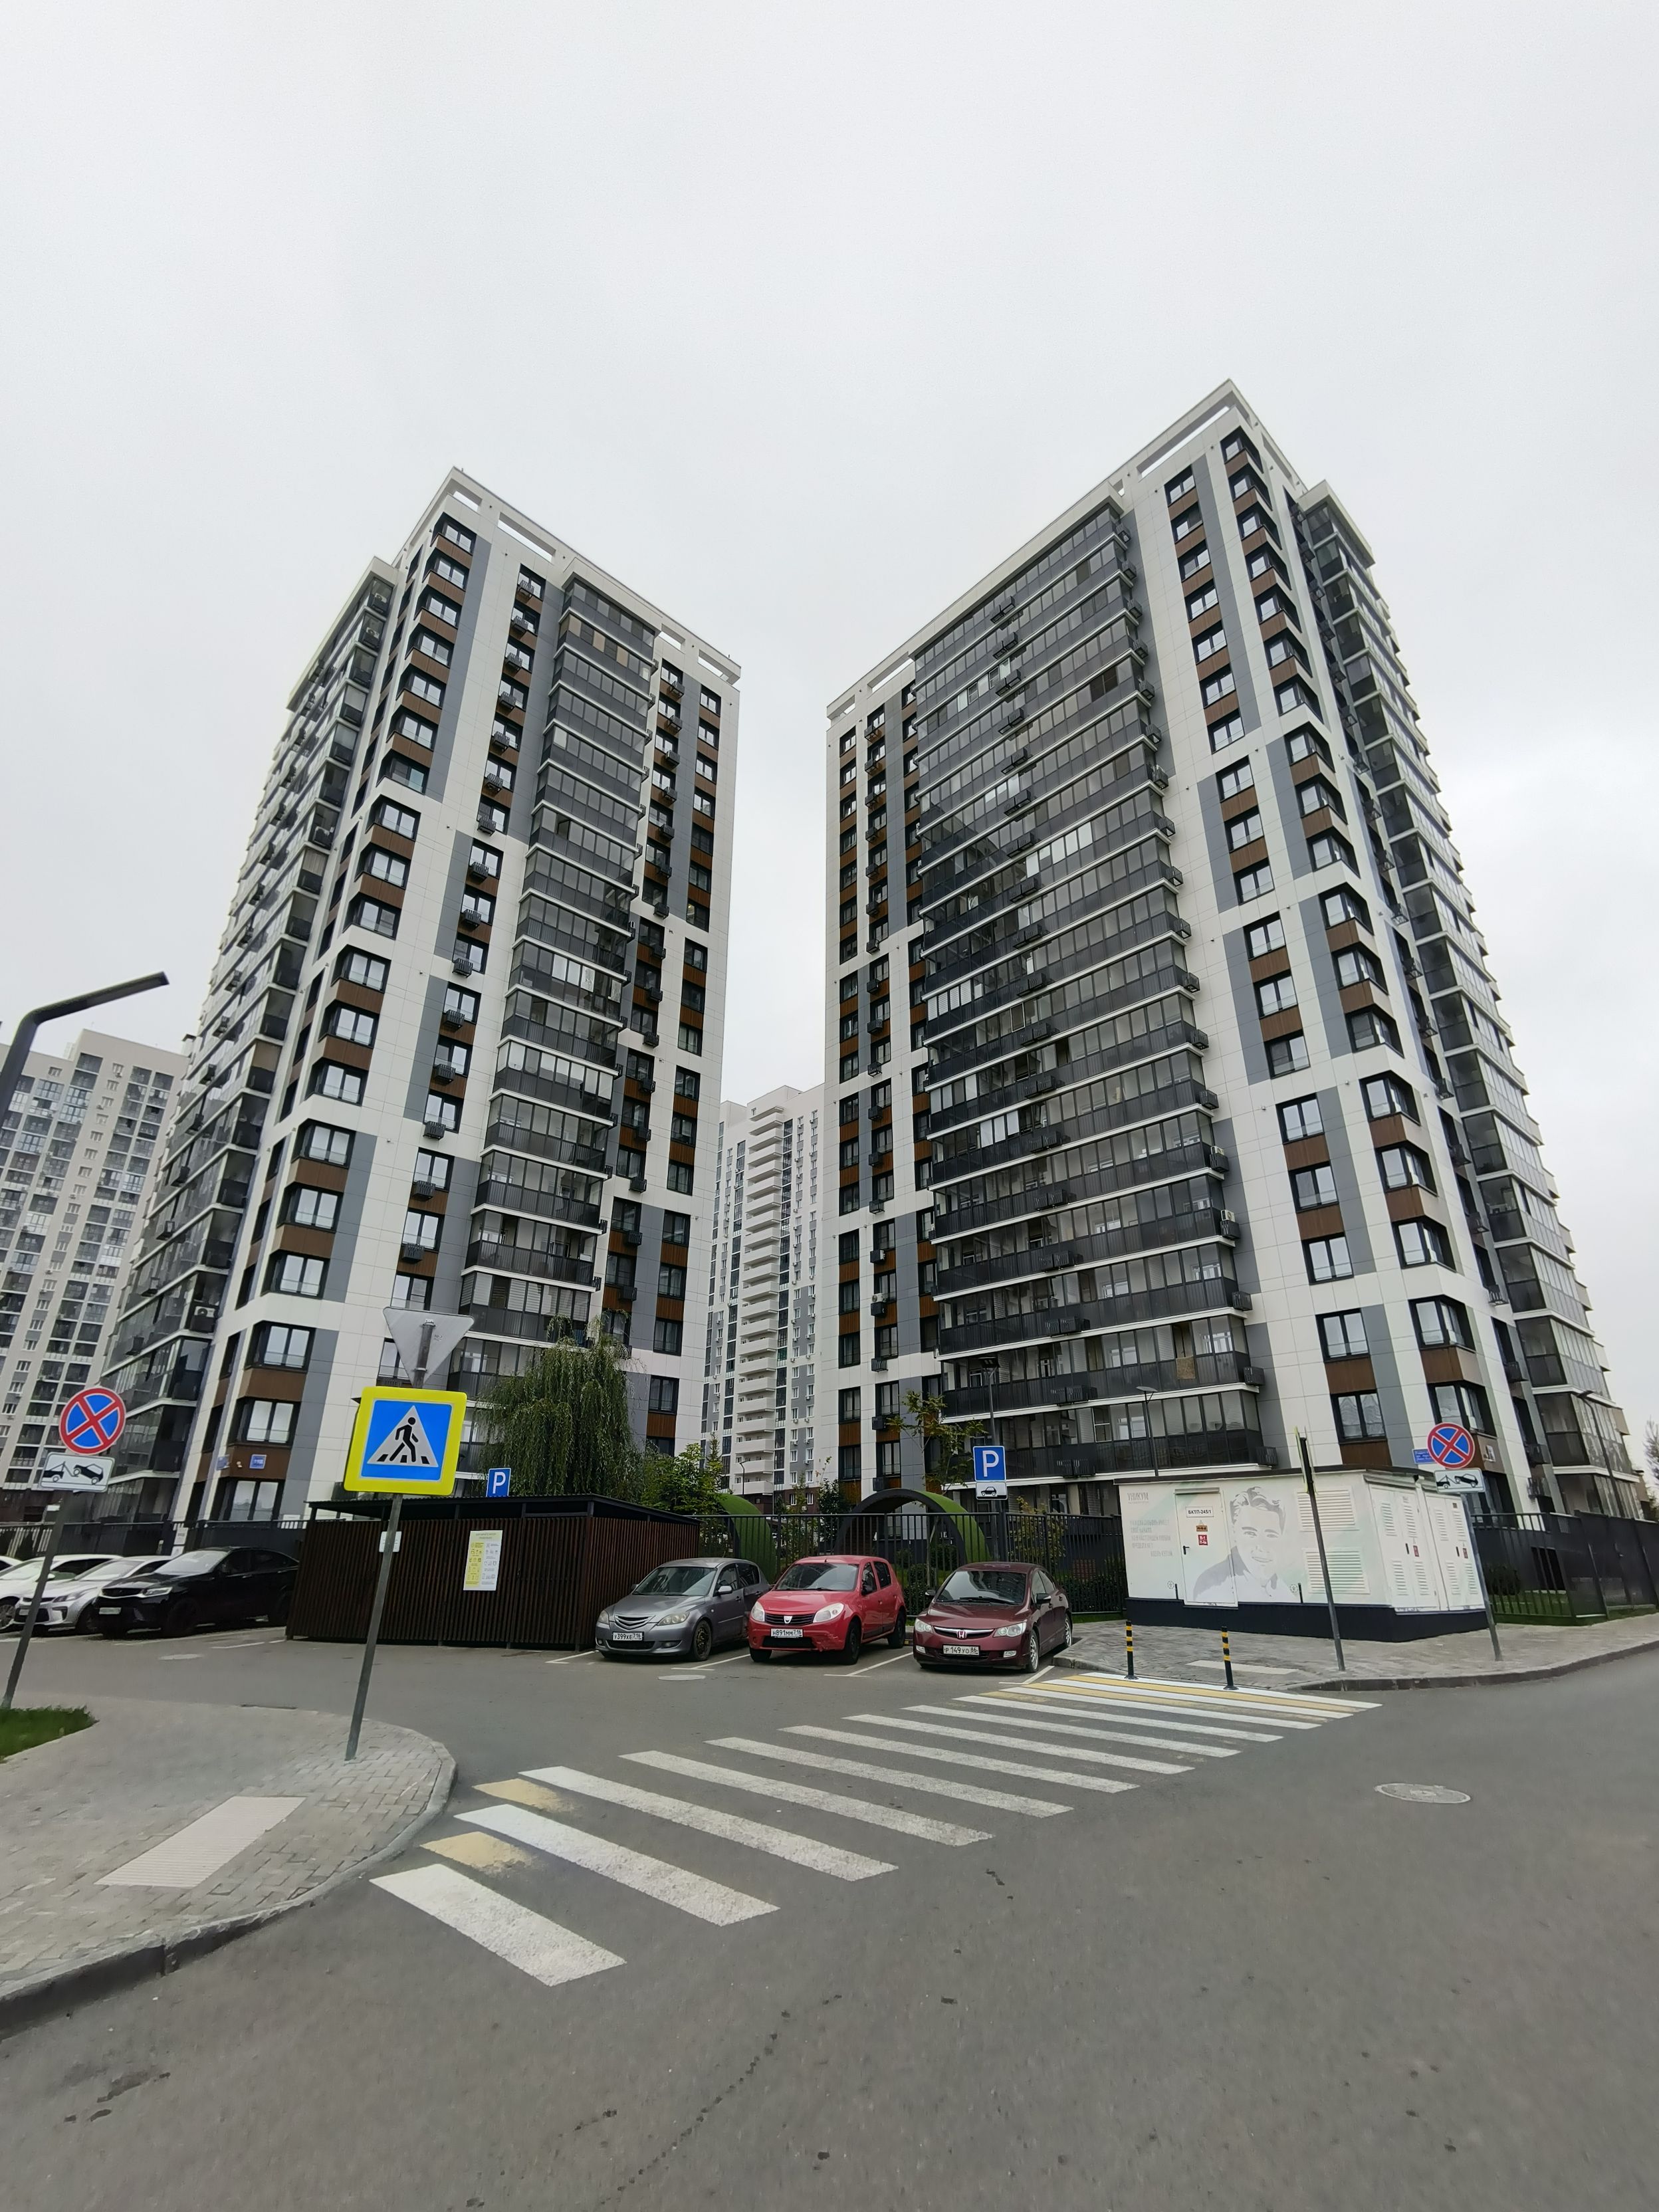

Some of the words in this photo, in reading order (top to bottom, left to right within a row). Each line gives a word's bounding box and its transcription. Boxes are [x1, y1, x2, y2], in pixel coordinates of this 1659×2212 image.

[982, 1450, 999, 1477] P
[493, 1472, 506, 1493] P
[1127, 1492, 1149, 1501] УНИКУМ
